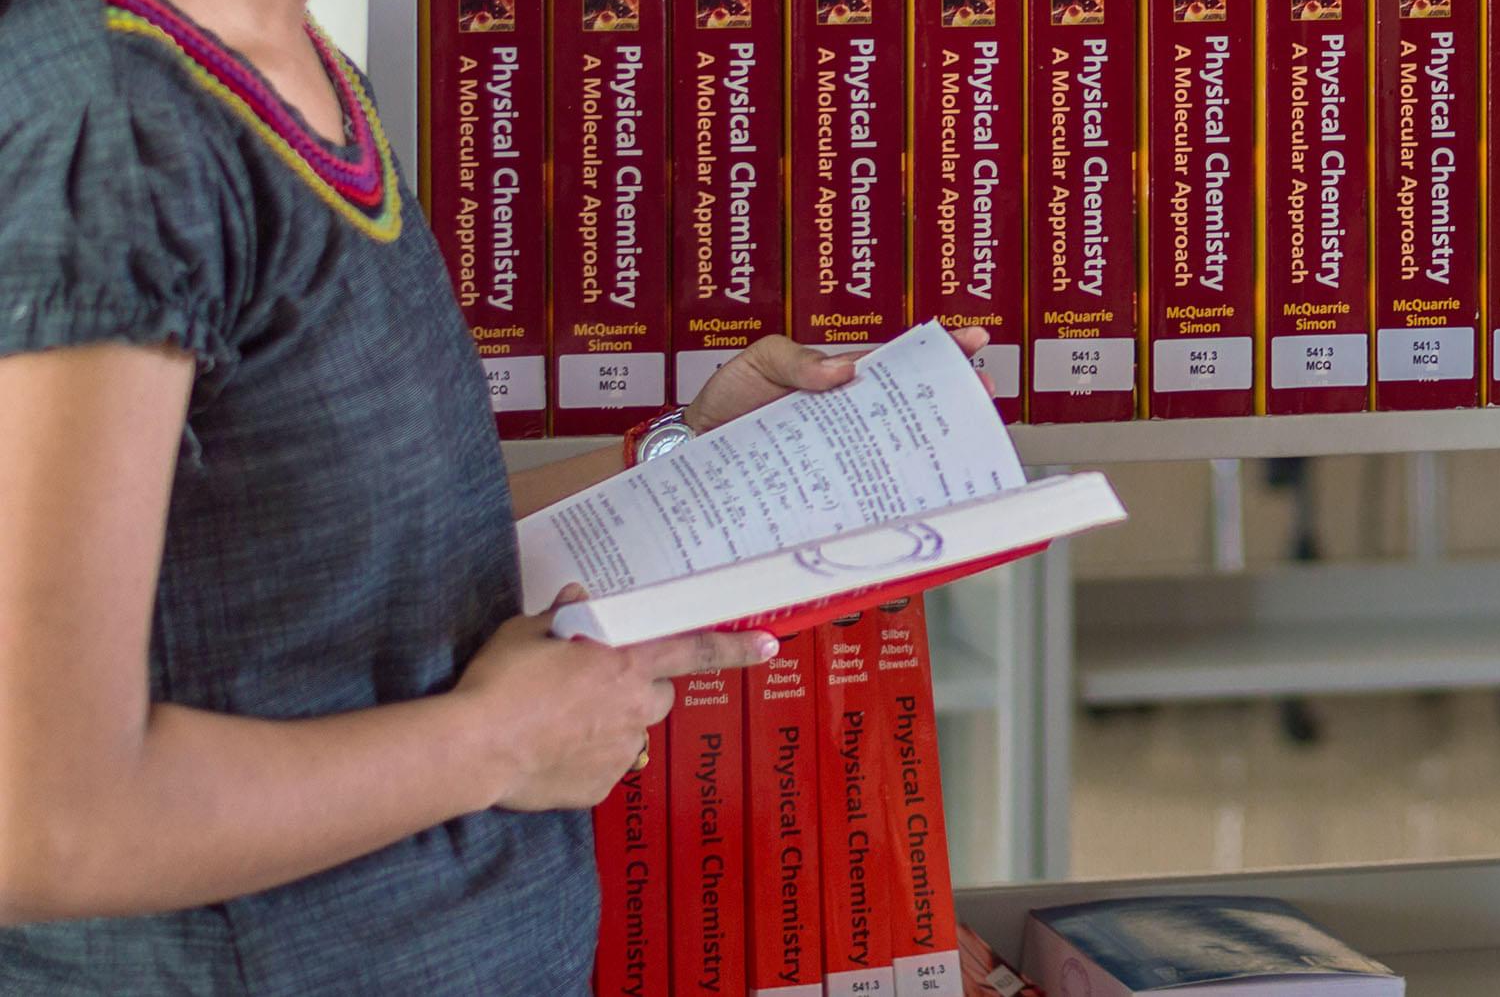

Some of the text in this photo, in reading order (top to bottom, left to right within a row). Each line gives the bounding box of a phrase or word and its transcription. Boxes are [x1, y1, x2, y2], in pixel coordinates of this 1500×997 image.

[1077, 39, 1109, 296] Physical Chemistry
[1315, 34, 1346, 289] Physical Chemistry
[693, 51, 717, 299] A Molecular Approach
[723, 43, 757, 303] Physical Chemistry
[844, 39, 877, 299] Physical Chemistry
[1048, 47, 1071, 291] A Molecular Approach
[486, 47, 520, 310] Physical Chemistry
[1167, 304, 1234, 319] McQuarrie
[1393, 298, 1460, 312] McQuarrie
[1406, 314, 1446, 327] Simon
[574, 322, 647, 336] McQuarrie
[1180, 322, 1220, 334] Simon
[589, 339, 632, 352] Simon
[1413, 342, 1440, 351] 541.3
[1190, 351, 1217, 361] 541.3
[1413, 355, 1438, 364] MCQ
[600, 367, 629, 376] 541.3
[1190, 365, 1215, 374] MCQ
[600, 381, 626, 390] MCQ
[881, 629, 910, 641] Silbey
[881, 644, 913, 656] Alberty
[769, 659, 798, 670] Silbey
[879, 658, 918, 671] Bawendi
[767, 674, 801, 685] Alberty
[764, 687, 805, 700] Bawendi
[893, 695, 935, 949] Physical Chemistry
[773, 726, 808, 984] Physical Chemistry
[693, 733, 729, 993] Physical Chemistry
[917, 965, 945, 977] 541.3
[923, 980, 939, 990] SIL
